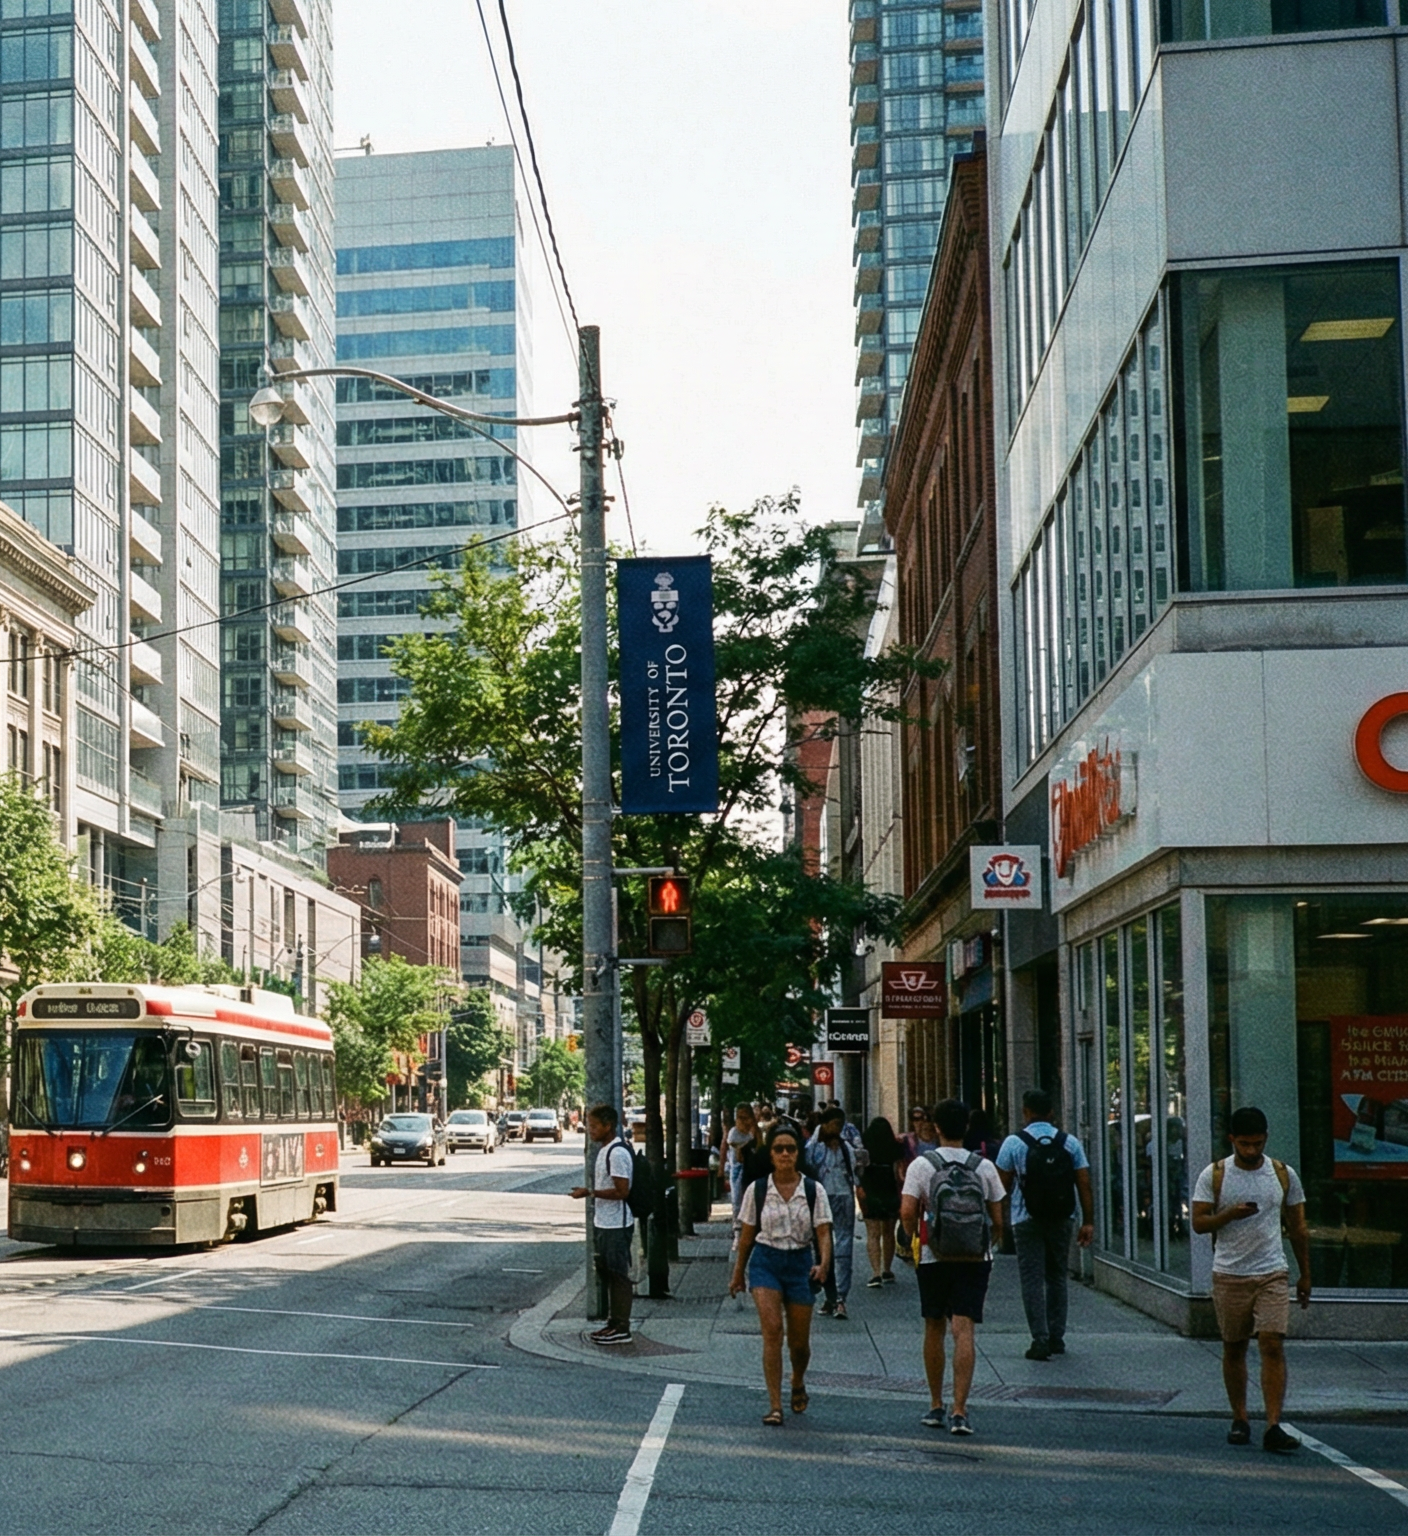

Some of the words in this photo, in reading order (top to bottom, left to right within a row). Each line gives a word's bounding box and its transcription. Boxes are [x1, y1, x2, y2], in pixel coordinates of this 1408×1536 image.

[648, 661, 658, 679] OF
[648, 688, 660, 777] UNIVERSITY
[665, 644, 690, 793] TORONTO
